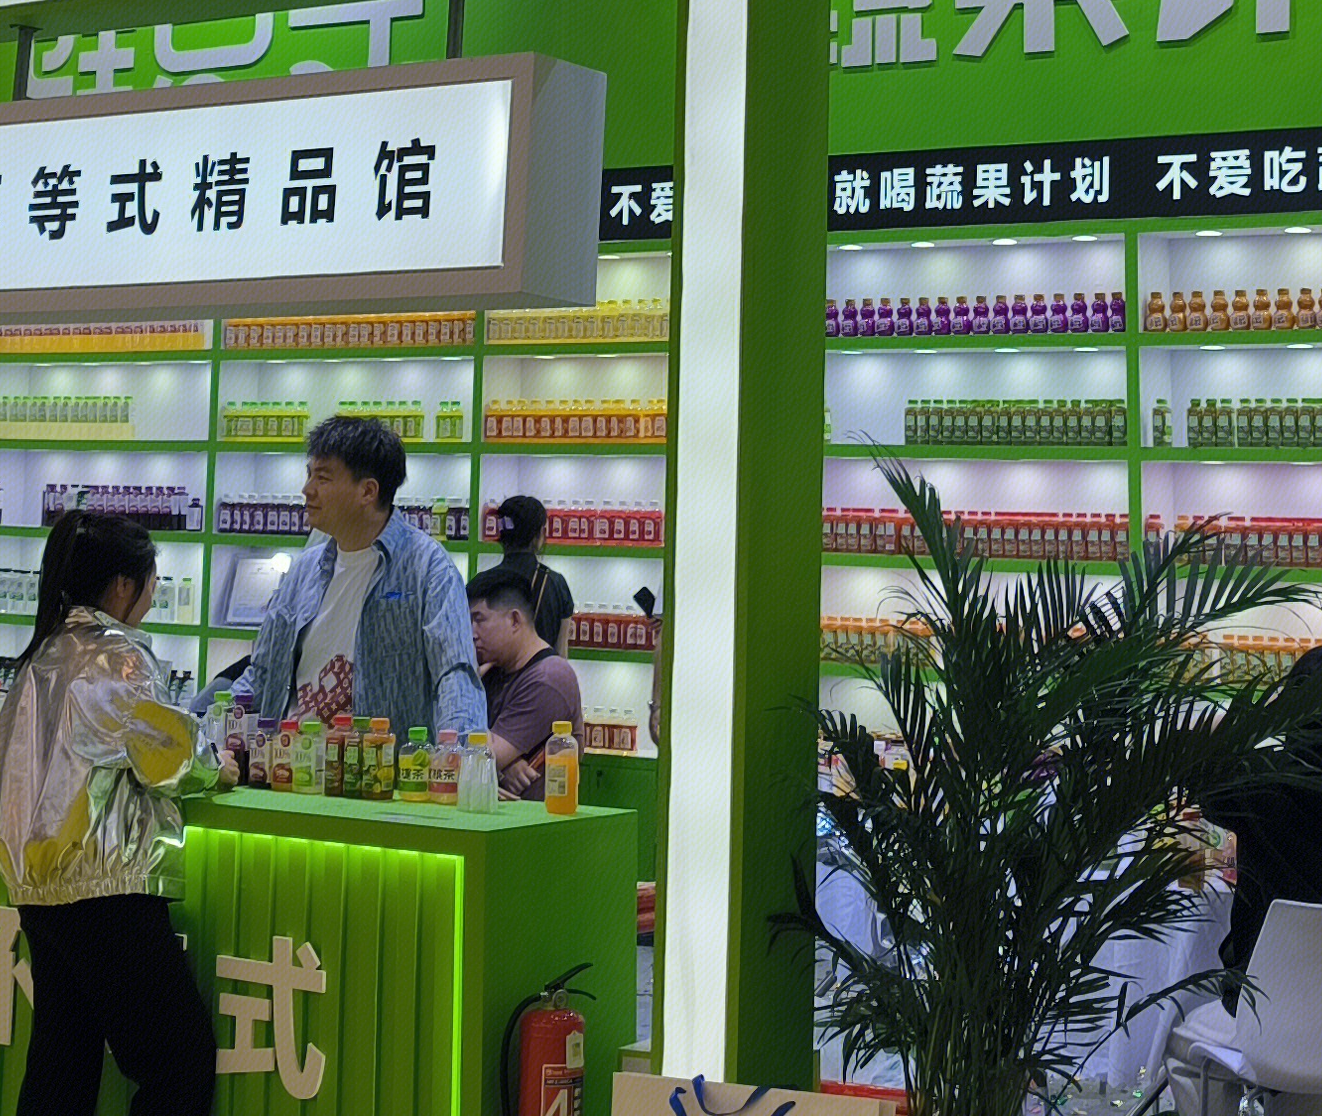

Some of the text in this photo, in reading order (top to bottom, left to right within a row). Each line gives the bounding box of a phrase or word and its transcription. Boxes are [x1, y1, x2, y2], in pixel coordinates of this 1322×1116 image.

[833, 155, 1111, 216] 就喝蔬果计划
